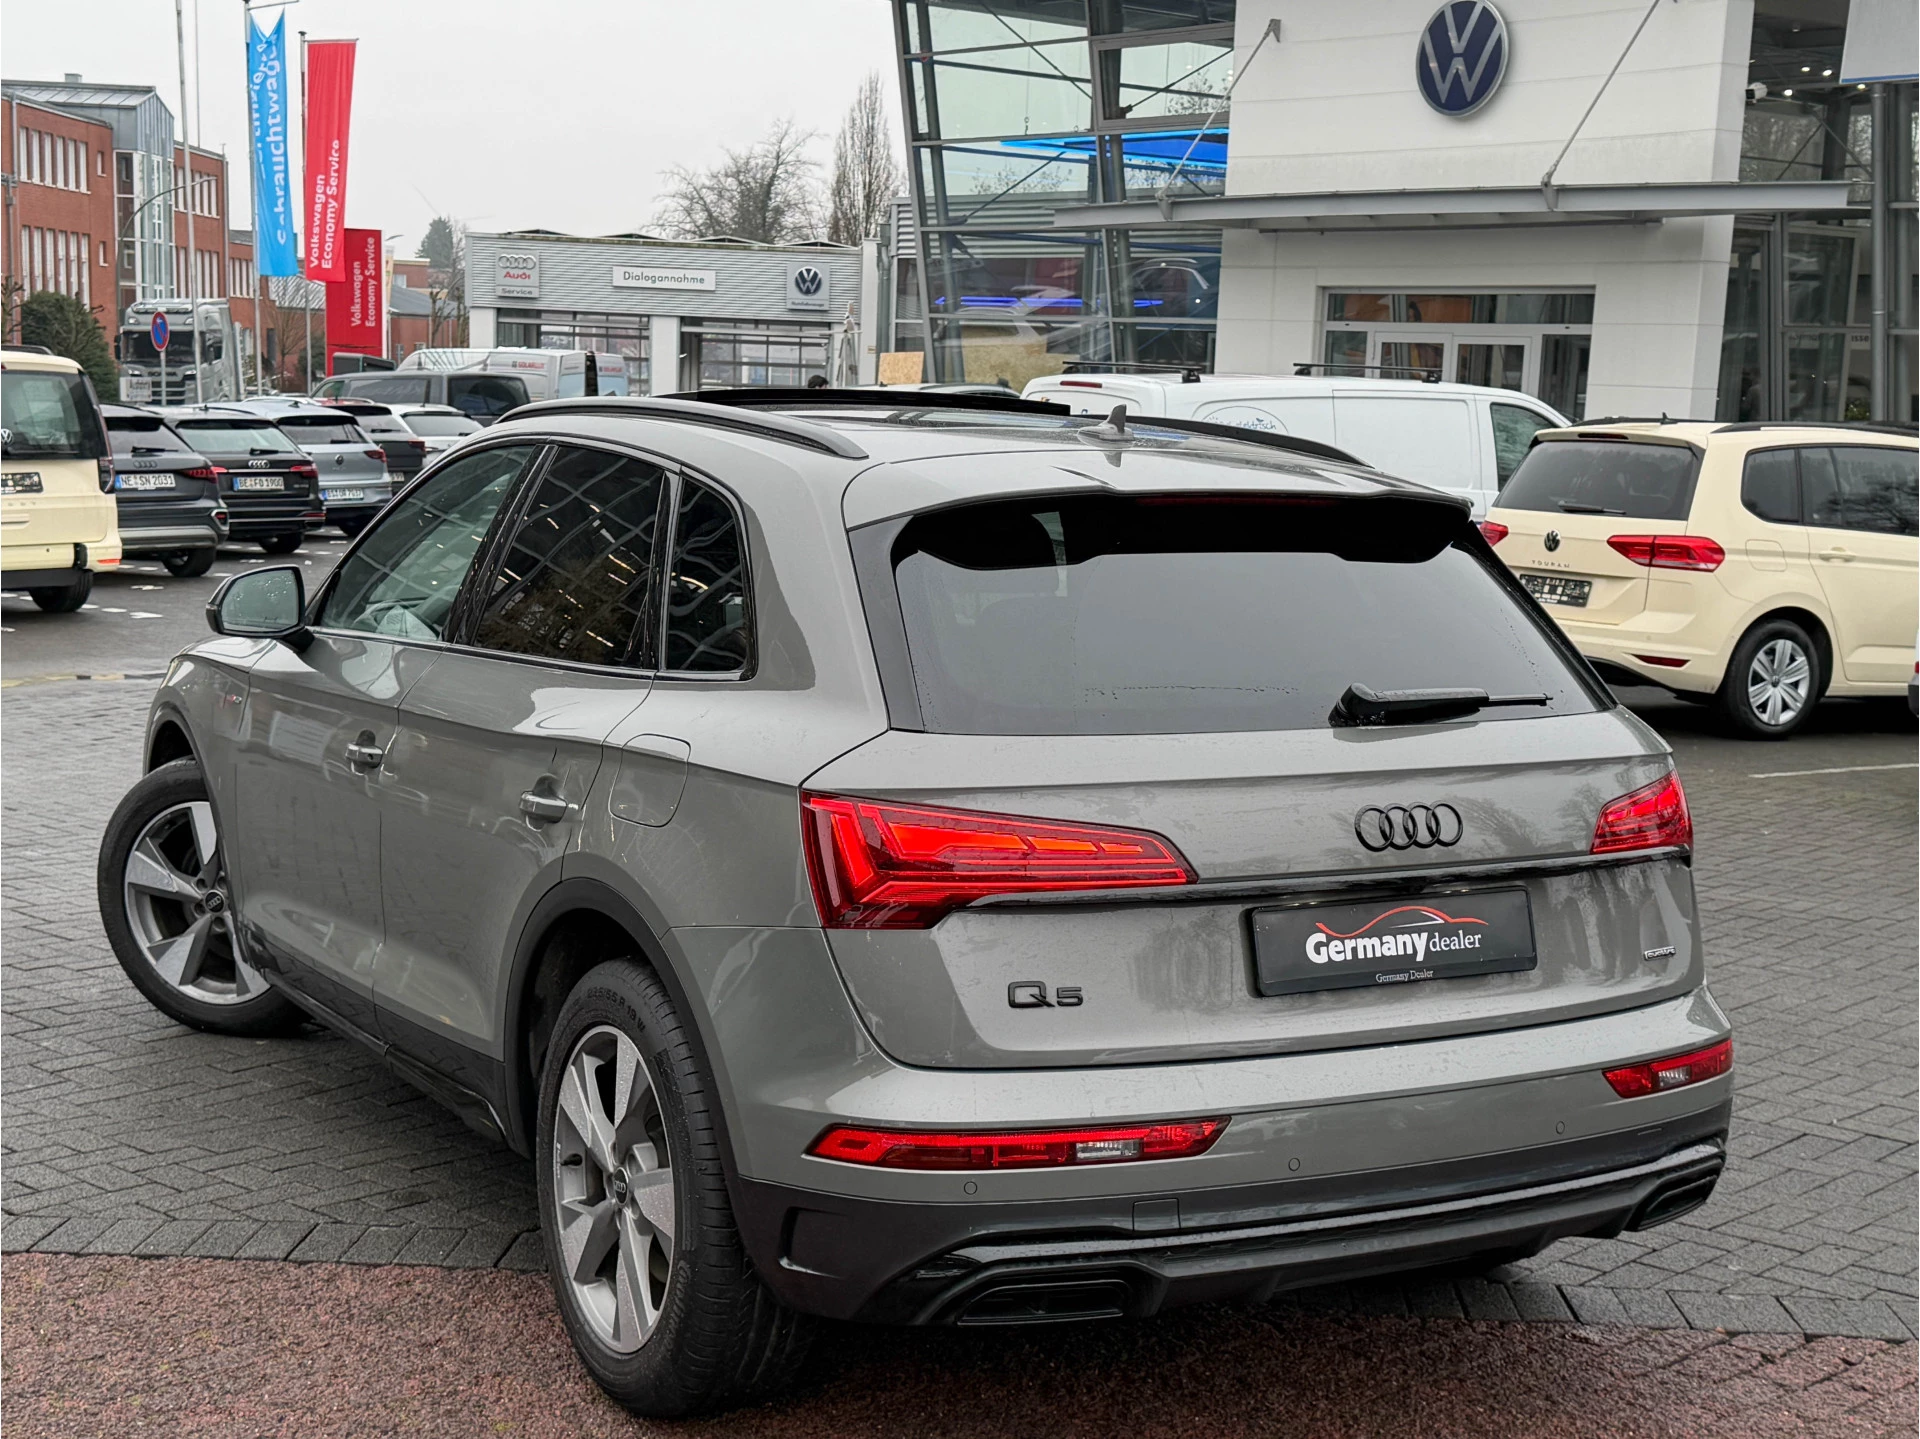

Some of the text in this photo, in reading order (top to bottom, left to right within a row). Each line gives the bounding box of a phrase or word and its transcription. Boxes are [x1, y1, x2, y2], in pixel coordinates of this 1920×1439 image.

[322, 139, 340, 269] Economy Service
[310, 174, 326, 268] Volkswagen
[365, 237, 377, 328] Economy Service
[501, 287, 533, 296] Service
[504, 271, 531, 280] Audi
[623, 271, 705, 285] Dialogannahme
[351, 261, 362, 327] Volkswagen
[1305, 929, 1482, 964] Germany dealer
[1375, 968, 1434, 983] Germany Dealer
[1008, 980, 1084, 1009] Q5
